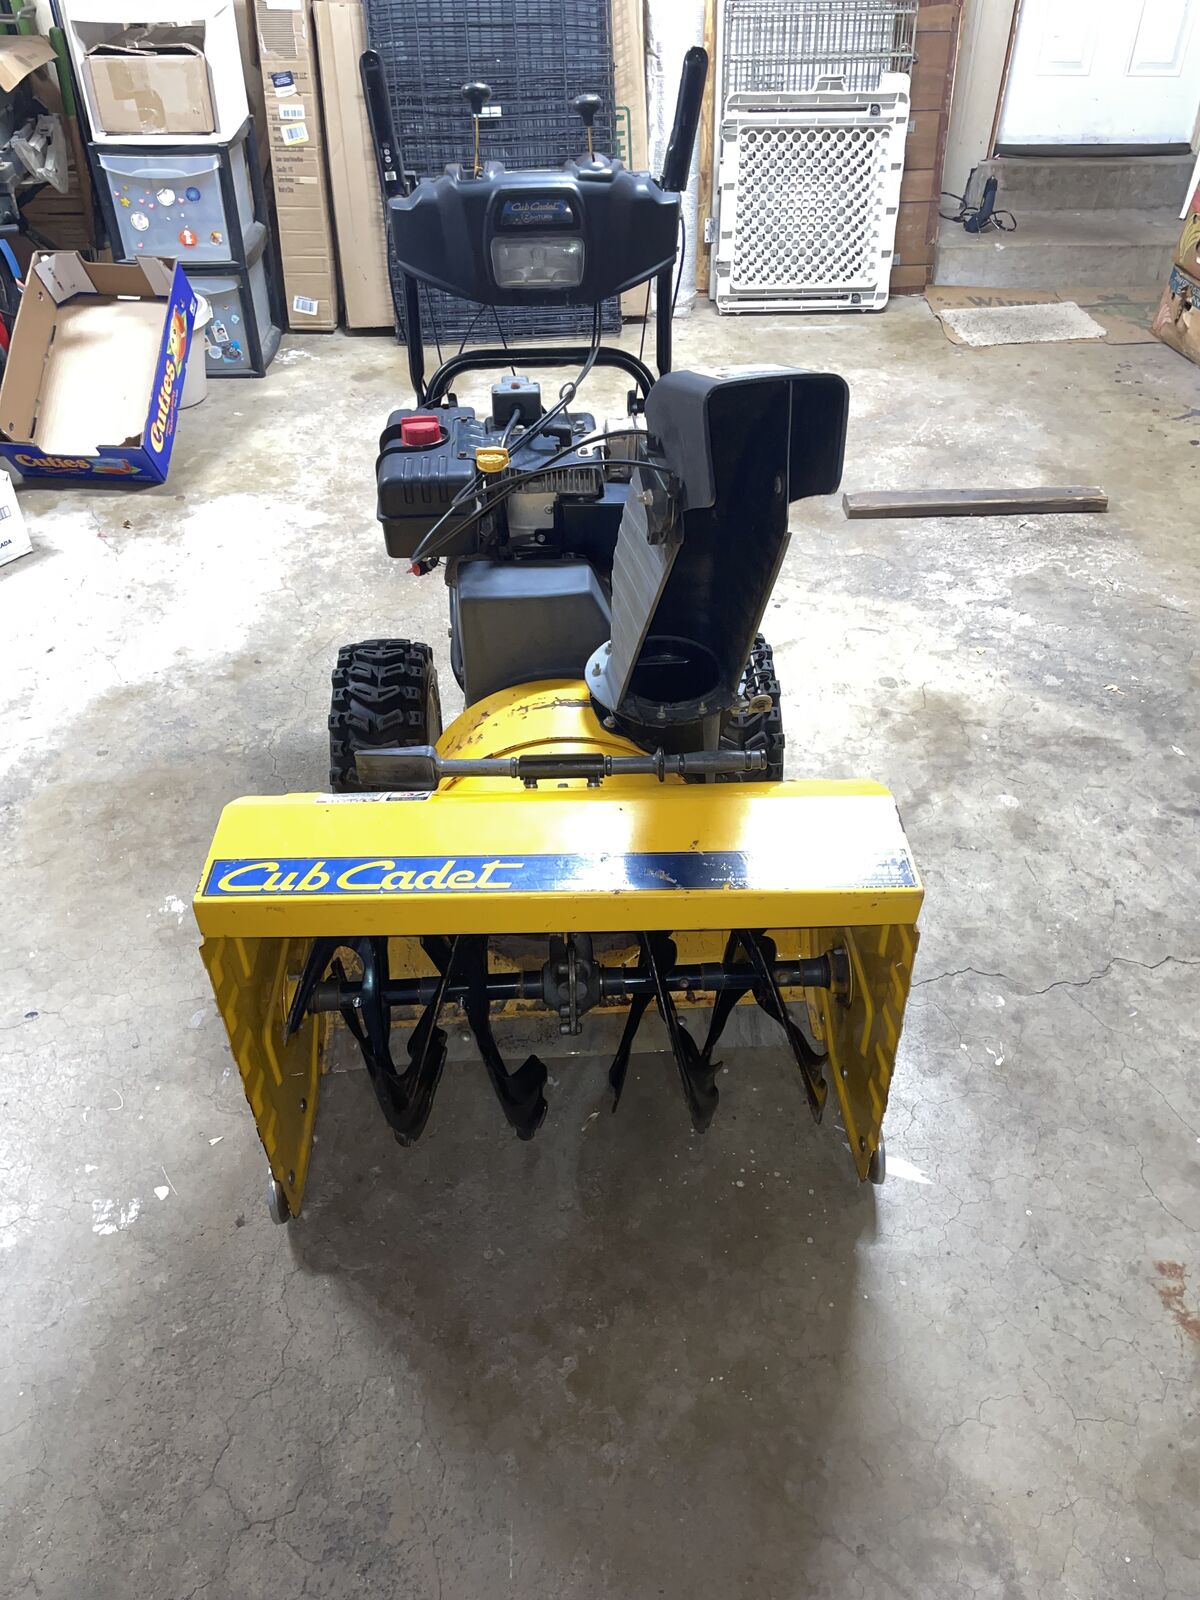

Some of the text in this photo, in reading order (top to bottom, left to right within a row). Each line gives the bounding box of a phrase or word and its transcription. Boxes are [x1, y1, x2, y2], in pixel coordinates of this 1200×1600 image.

[512, 202, 561, 211] Cub Cadet
[151, 360, 175, 453] Cuties
[15, 454, 90, 469] Cuties
[218, 860, 525, 892] Cub Cadet
